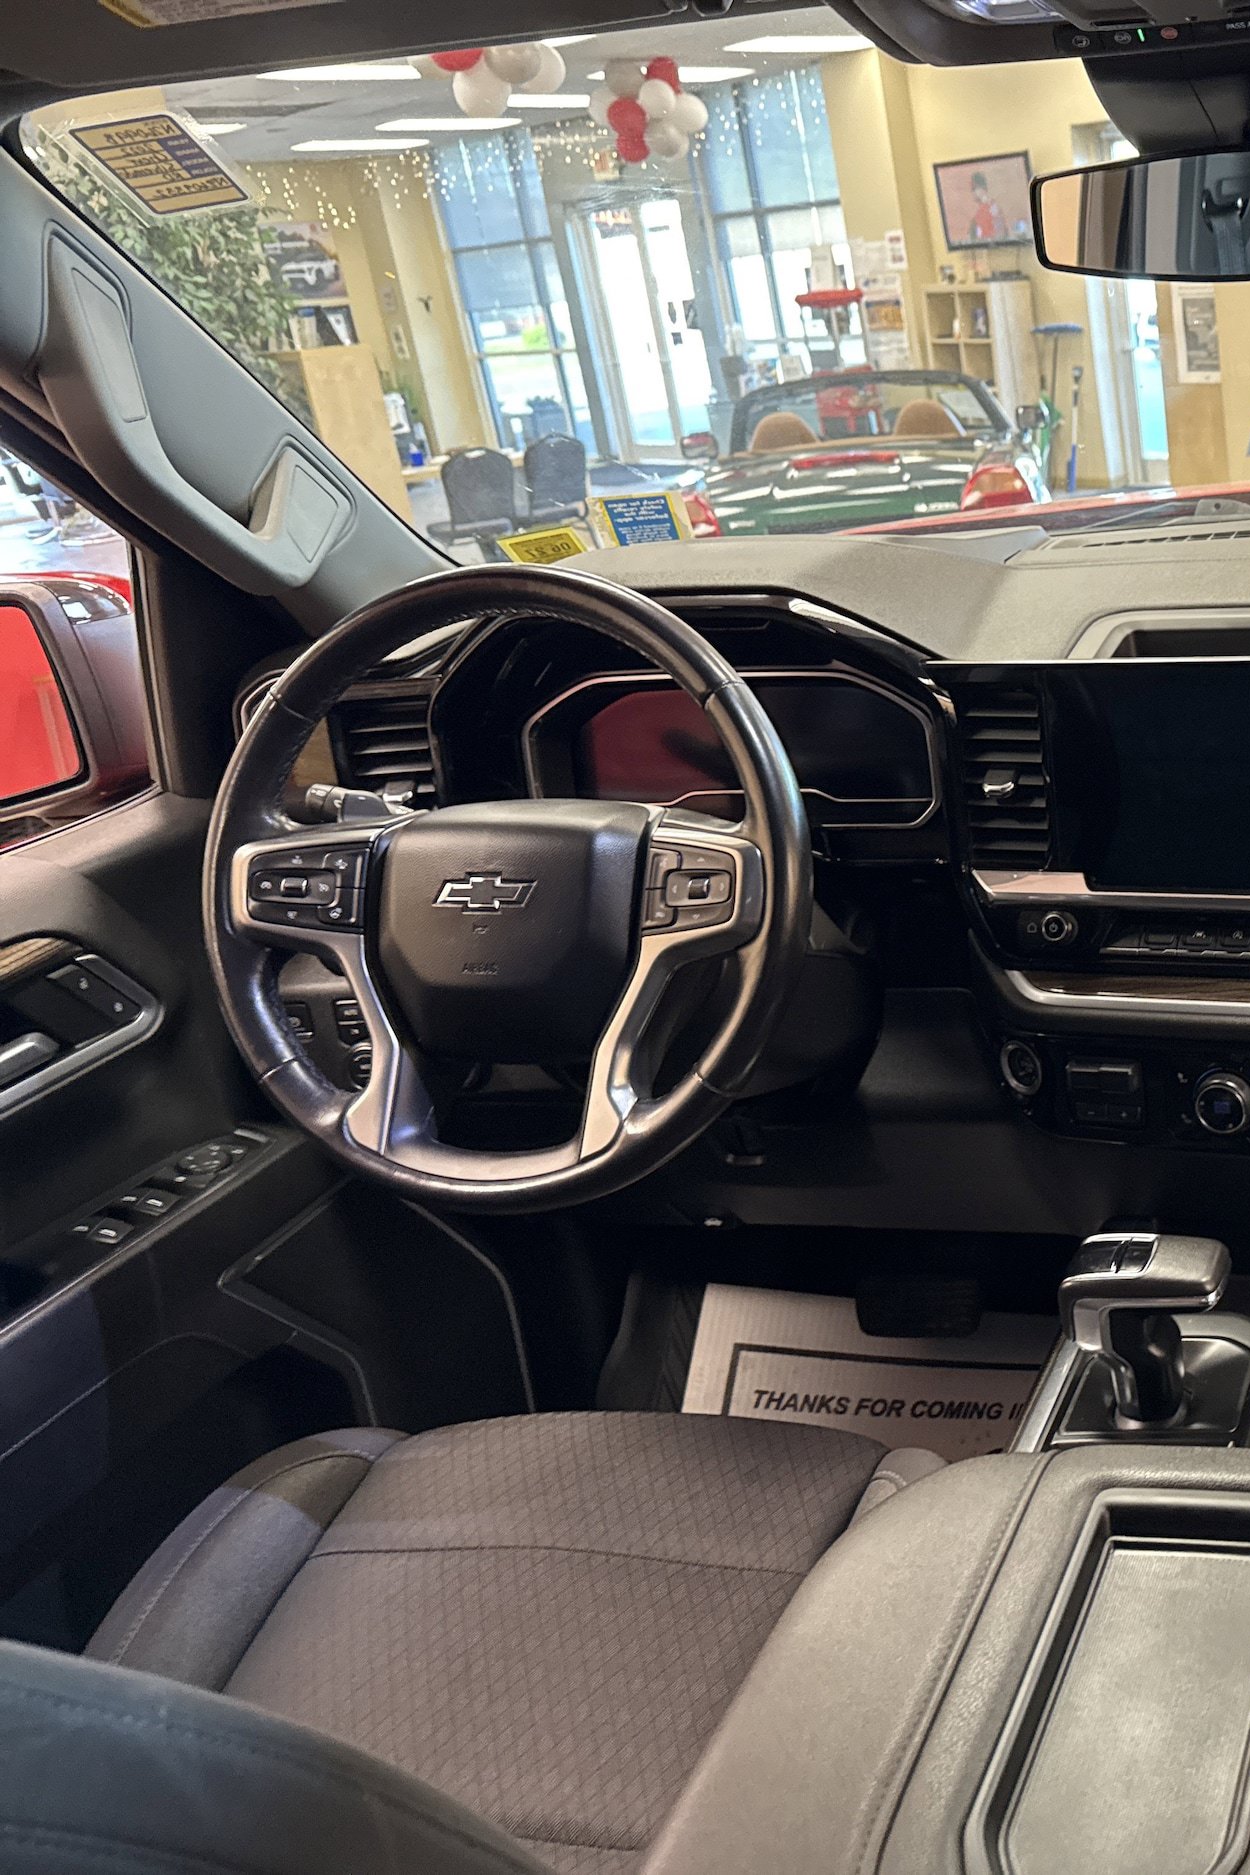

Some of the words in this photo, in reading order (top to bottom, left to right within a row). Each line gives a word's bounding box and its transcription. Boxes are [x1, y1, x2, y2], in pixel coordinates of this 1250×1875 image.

[753, 1389, 849, 1416] THANKS
[854, 1398, 906, 1418] FOR
[910, 1400, 1003, 1420] COMING
